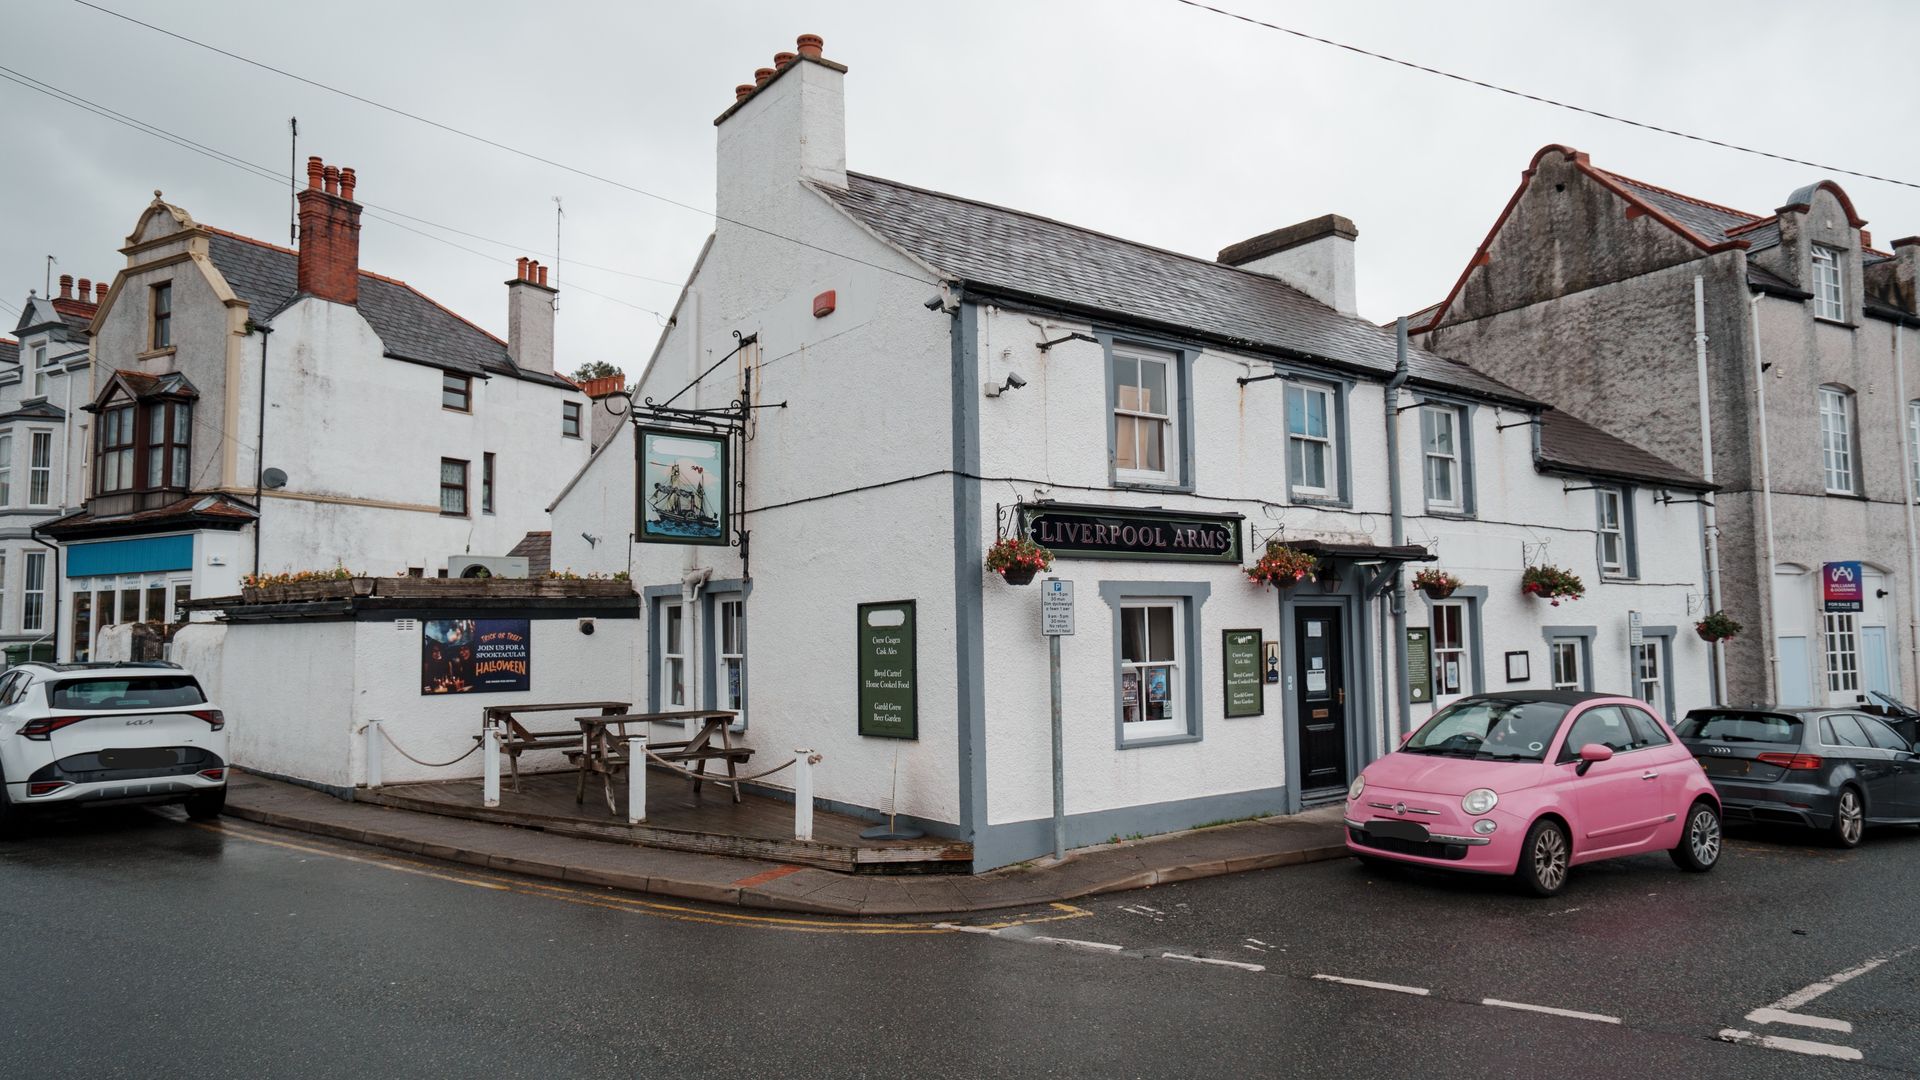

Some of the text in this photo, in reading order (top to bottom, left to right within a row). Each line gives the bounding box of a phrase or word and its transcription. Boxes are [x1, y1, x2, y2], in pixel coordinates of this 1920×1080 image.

[1040, 520, 1226, 550] LIVERPOOL ARMS
[476, 660, 526, 676] HALLOWEEN
[885, 714, 901, 722] Garden
